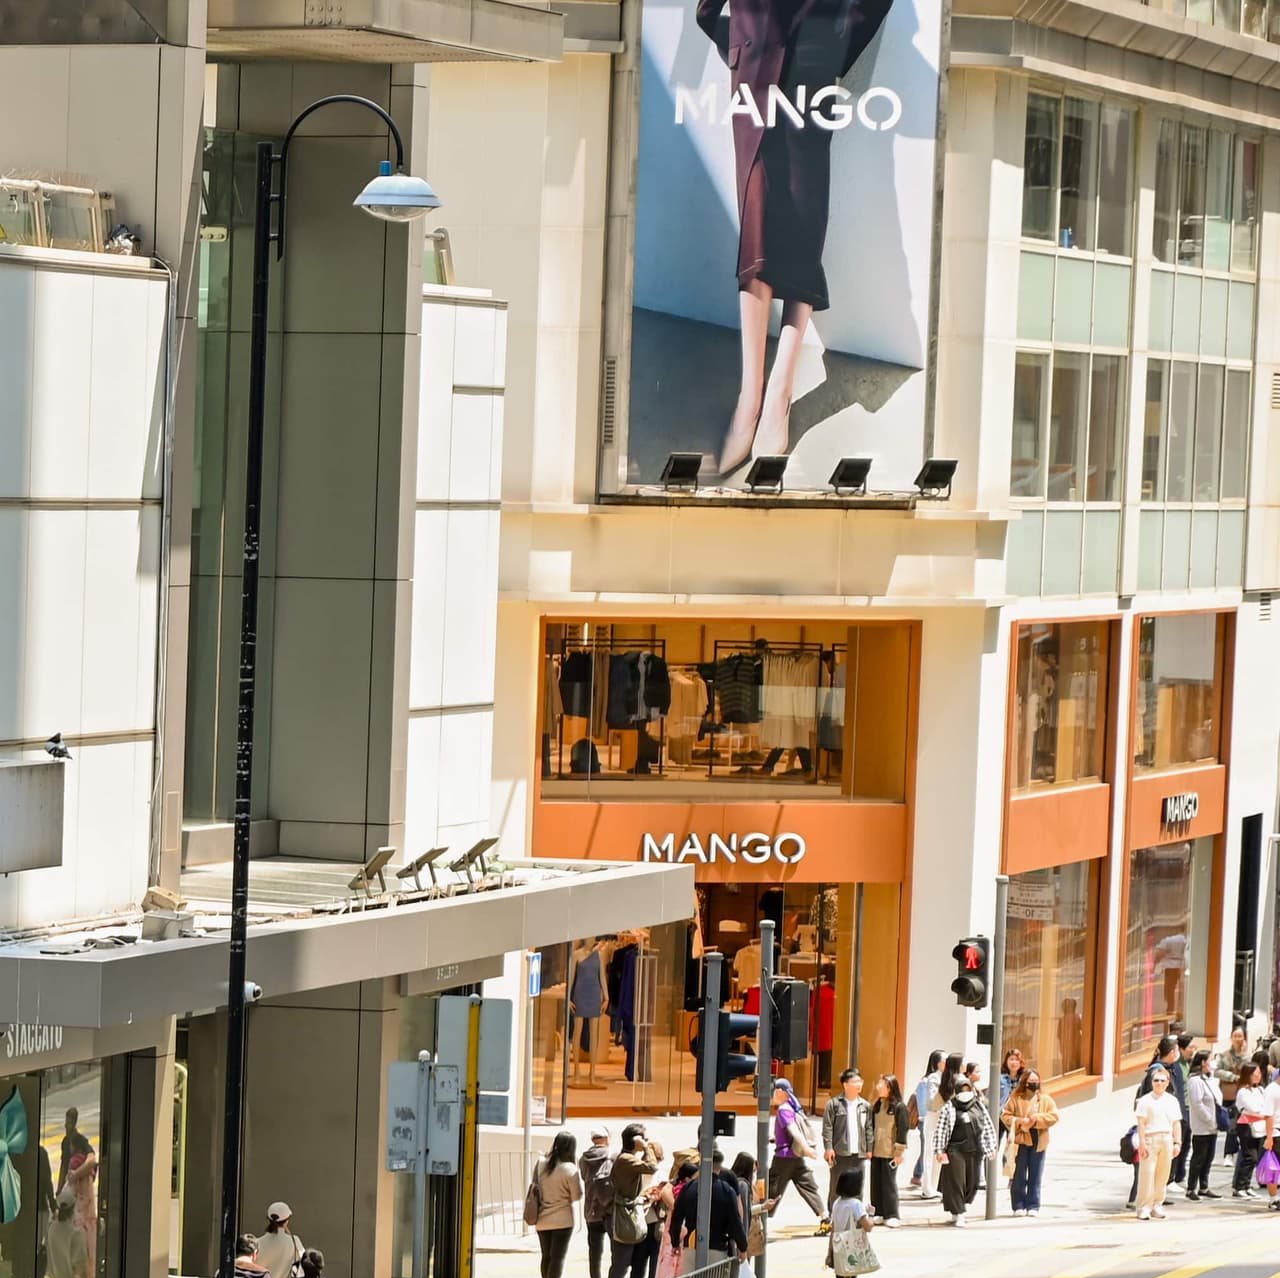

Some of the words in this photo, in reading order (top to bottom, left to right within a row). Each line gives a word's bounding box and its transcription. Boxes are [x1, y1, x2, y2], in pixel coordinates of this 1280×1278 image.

[675, 82, 902, 132] MANGO
[1167, 792, 1199, 823] MANGO
[643, 832, 806, 864] MANGO
